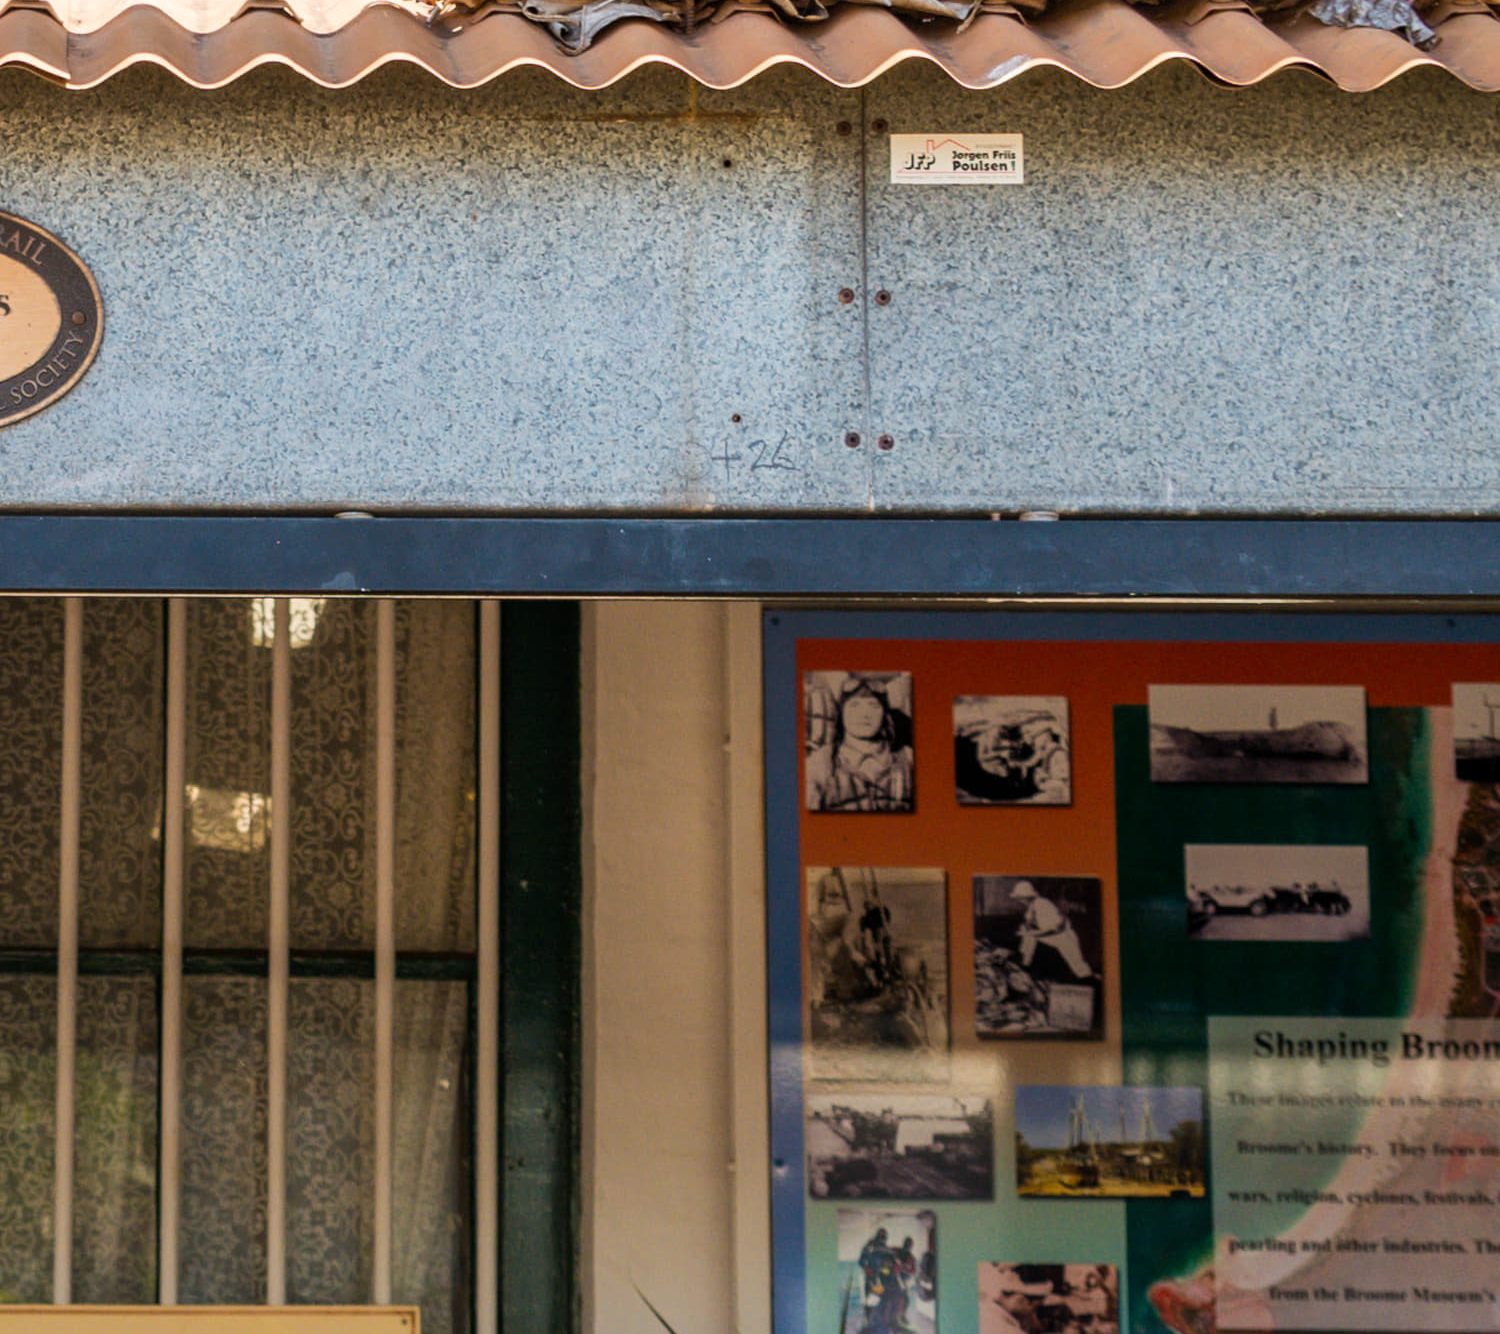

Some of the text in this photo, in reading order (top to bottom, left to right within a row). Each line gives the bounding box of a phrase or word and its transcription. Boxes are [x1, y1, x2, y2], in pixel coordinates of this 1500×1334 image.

[952, 160, 1008, 171] Poulsen
[10, 331, 86, 405] SOCIETY
[1253, 1030, 1390, 1067] Shaping
[1237, 1140, 1313, 1155] Broome's
[1317, 1141, 1378, 1159] history.
[1388, 1142, 1427, 1158] They
[1228, 1191, 1271, 1205] wars,
[1277, 1189, 1343, 1207] religion,
[1347, 1191, 1420, 1208] cyclones,
[1424, 1191, 1494, 1206] festivals,
[1228, 1239, 1297, 1256] pearling
[1301, 1239, 1331, 1253] and
[1336, 1240, 1379, 1253] other
[1384, 1240, 1468, 1254] industries.
[1269, 1287, 1309, 1302] from
[1313, 1288, 1338, 1302] the
[1344, 1287, 1408, 1302] Broome
[1412, 1287, 1496, 1303] Museum's
